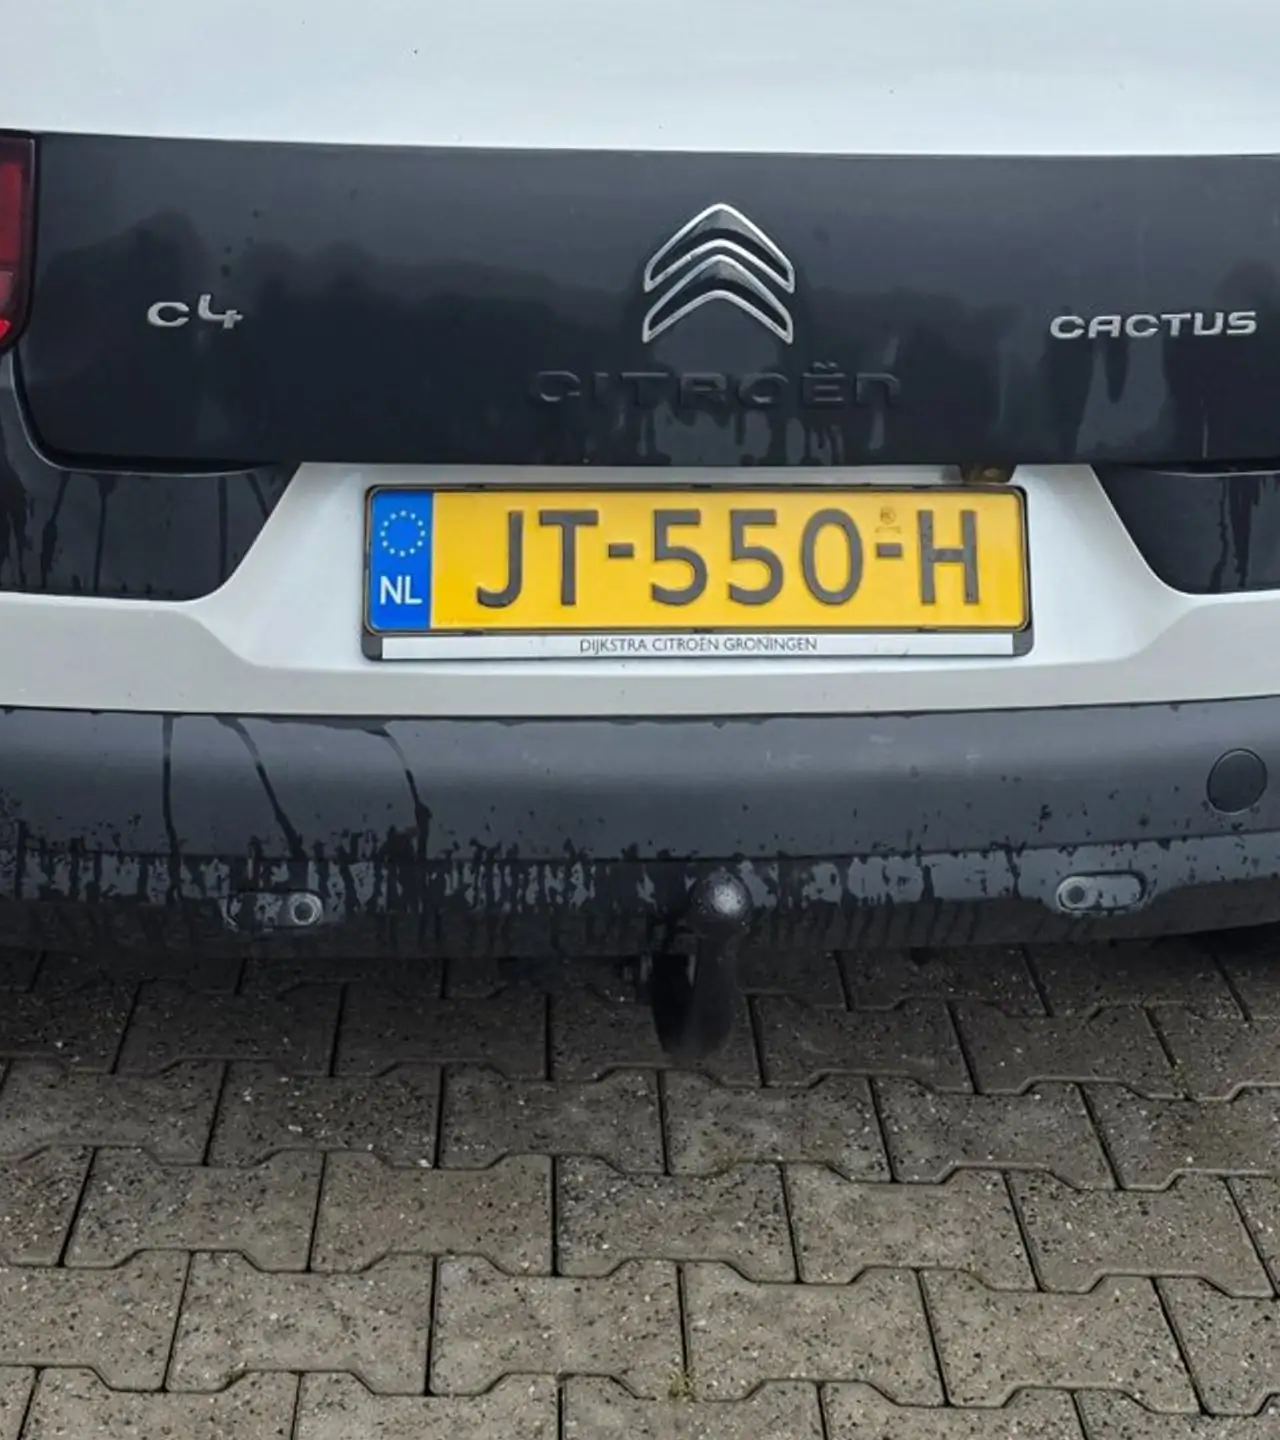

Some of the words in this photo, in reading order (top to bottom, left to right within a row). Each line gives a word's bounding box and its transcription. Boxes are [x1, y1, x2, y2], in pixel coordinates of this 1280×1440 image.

[147, 293, 244, 329] C4
[1049, 311, 1258, 340] CACTUS
[529, 361, 901, 406] CITROËN
[475, 507, 981, 609] JT-550-H
[379, 575, 423, 606] NL
[579, 638, 648, 655] DIJKSTRA
[723, 636, 819, 652] GRONINGEN
